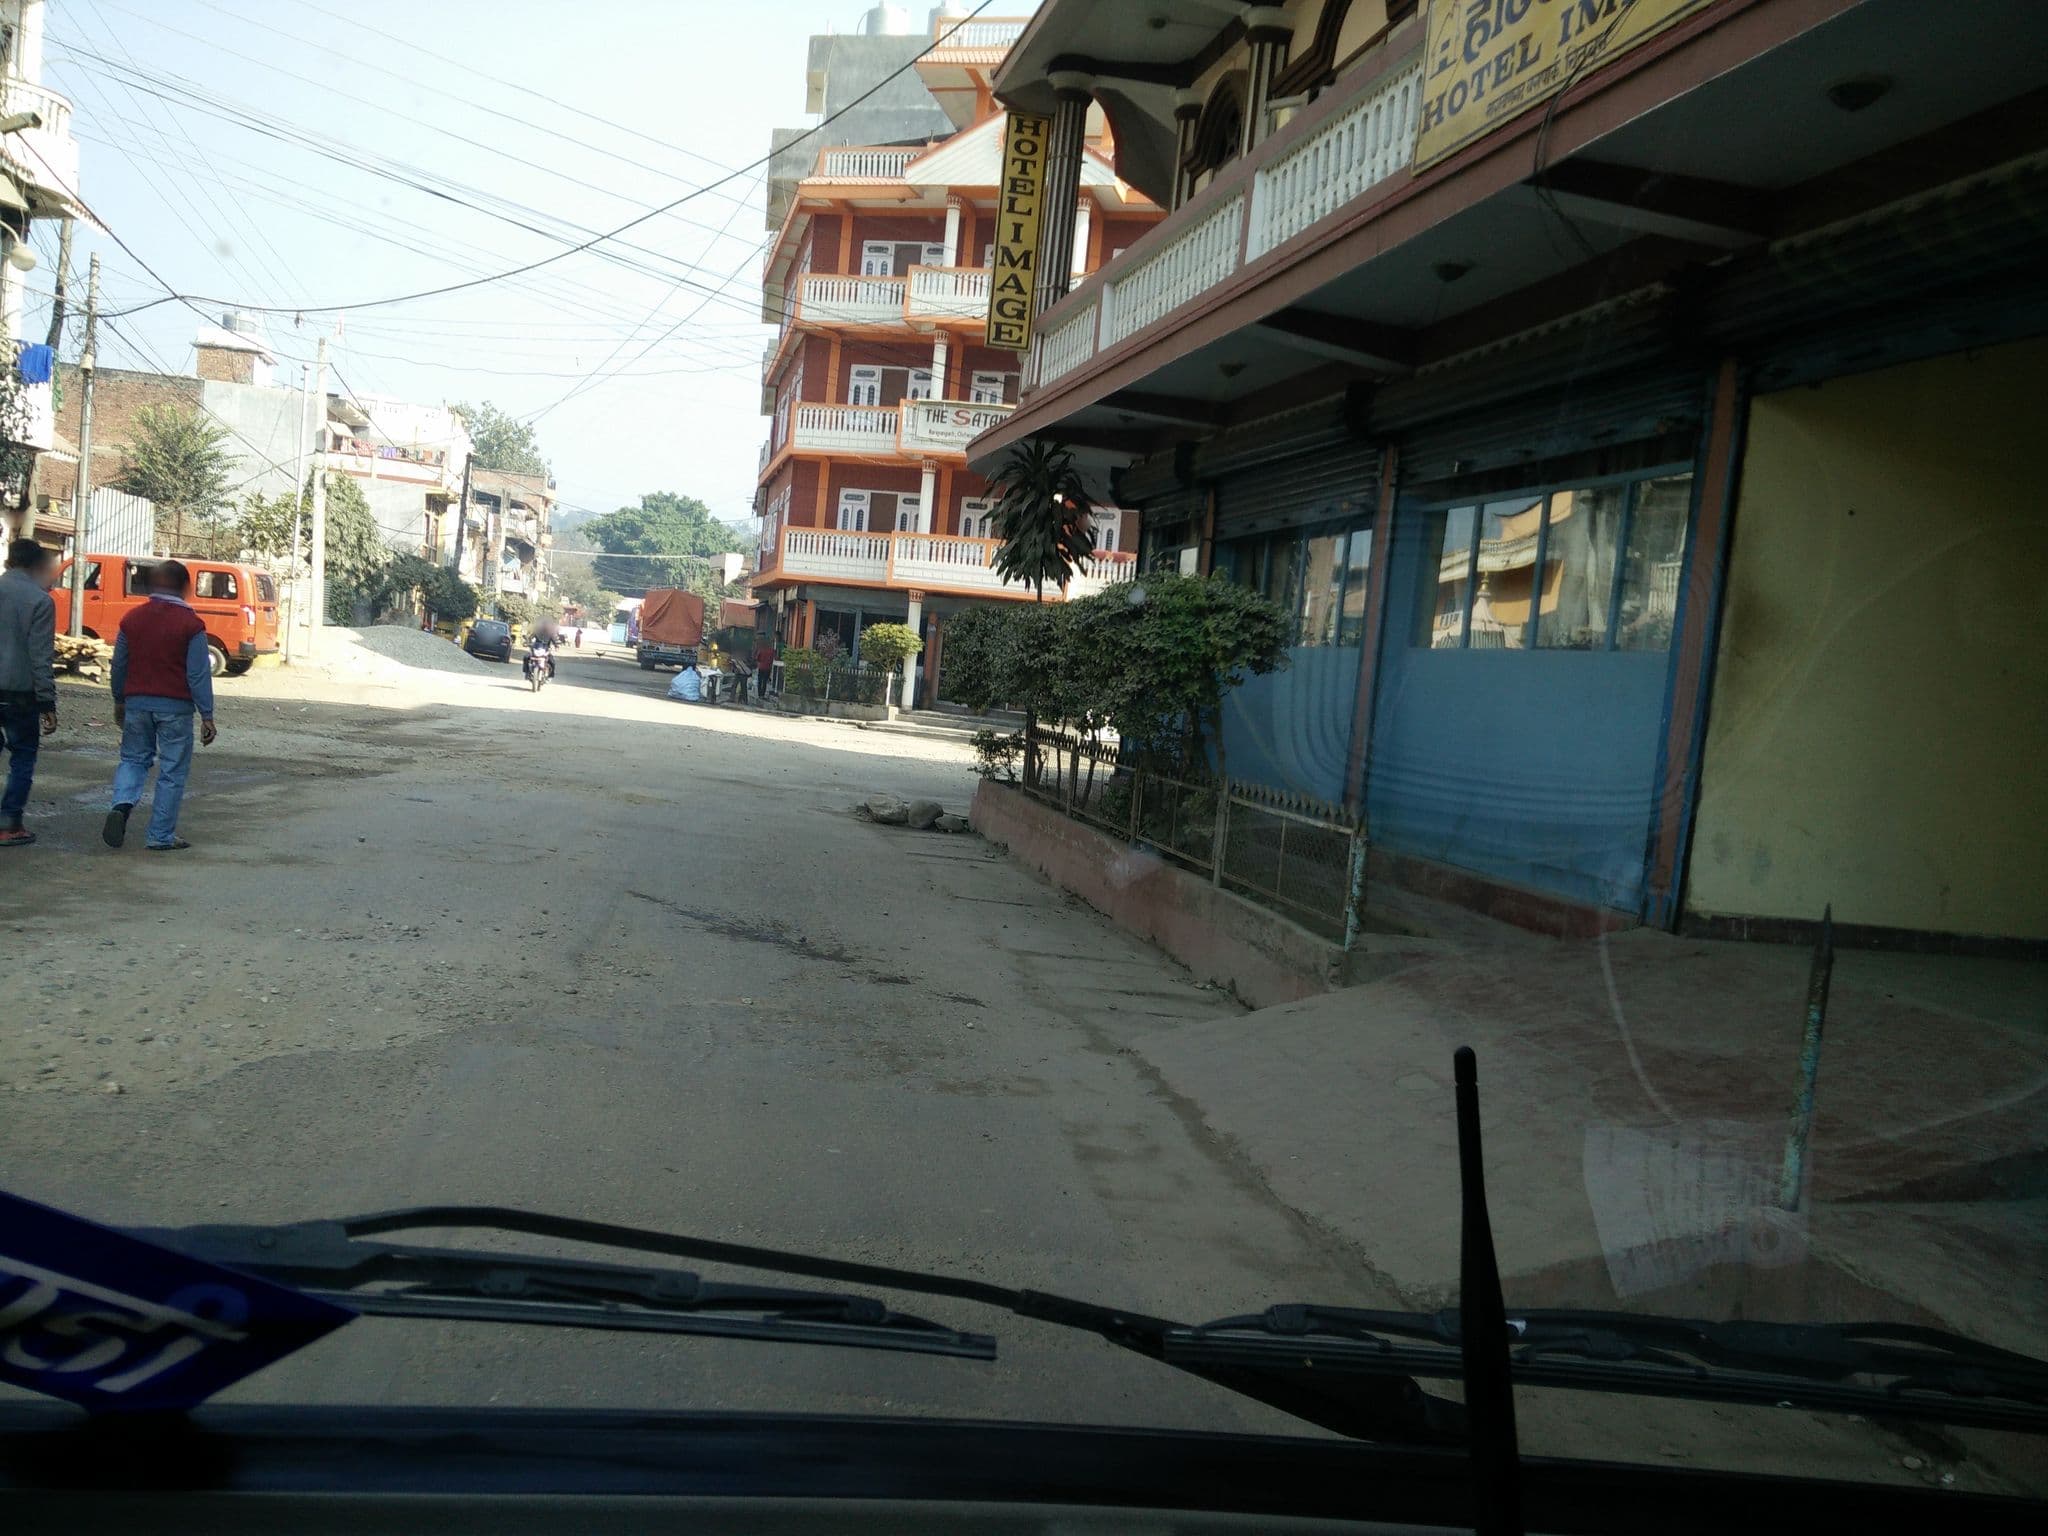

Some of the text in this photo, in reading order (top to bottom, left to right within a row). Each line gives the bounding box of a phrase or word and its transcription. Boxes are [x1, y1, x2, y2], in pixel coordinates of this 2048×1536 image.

[1421, 32, 1542, 135] HOTEL
[1558, 0, 1634, 48] IM
[992, 117, 1043, 345] HOTEL IMAGE
[926, 408, 949, 424] THE
